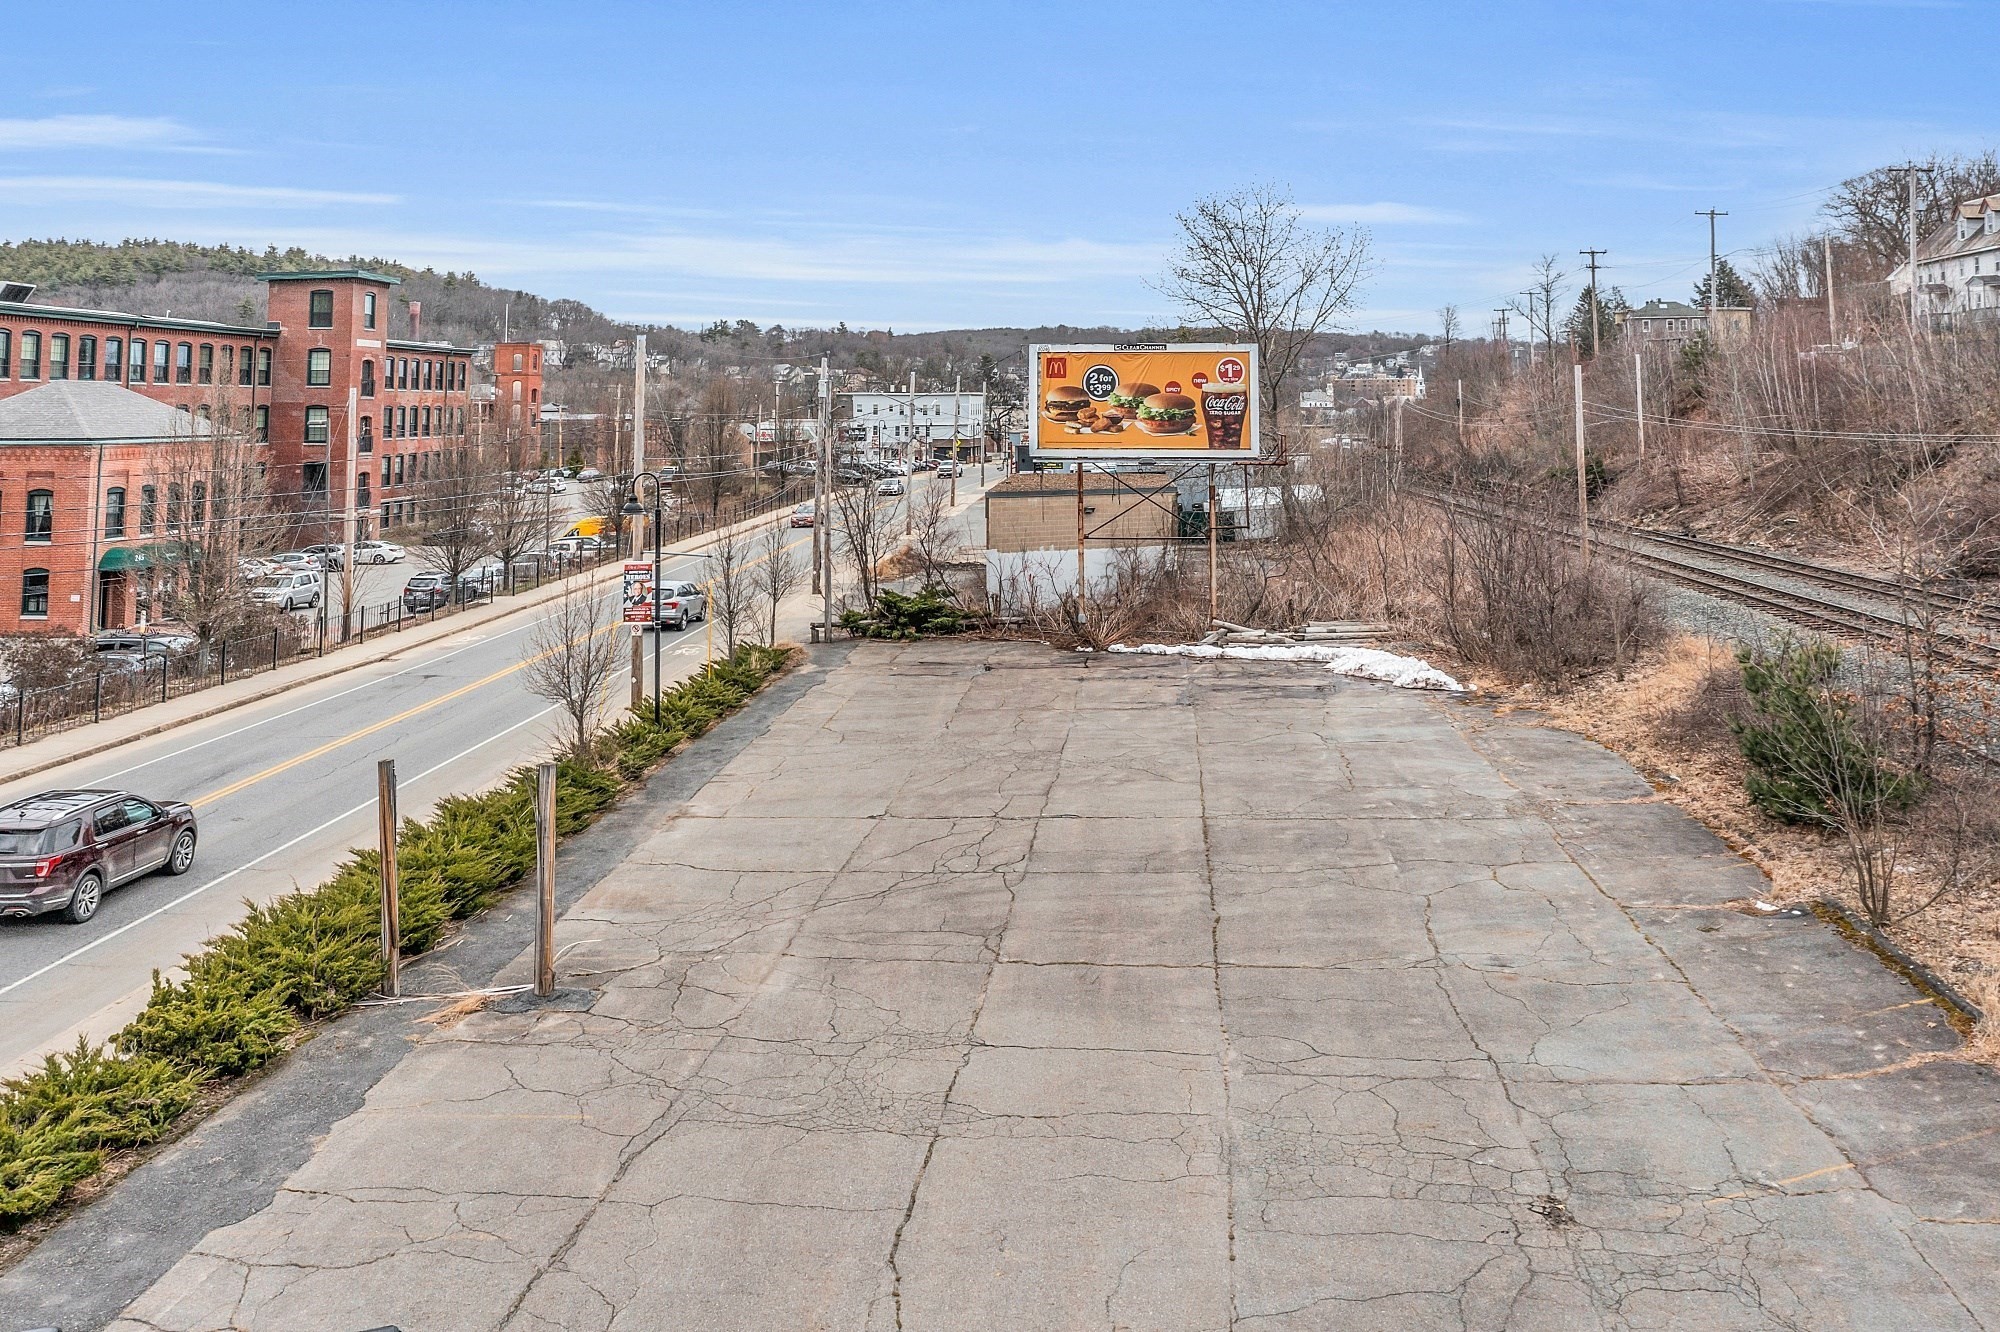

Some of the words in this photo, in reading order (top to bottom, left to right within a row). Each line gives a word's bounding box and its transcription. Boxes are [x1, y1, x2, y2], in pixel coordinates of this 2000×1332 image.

[1089, 372, 1099, 384] 2
[1099, 373, 1113, 382] for
[1205, 395, 1245, 411] Coca-Cola
